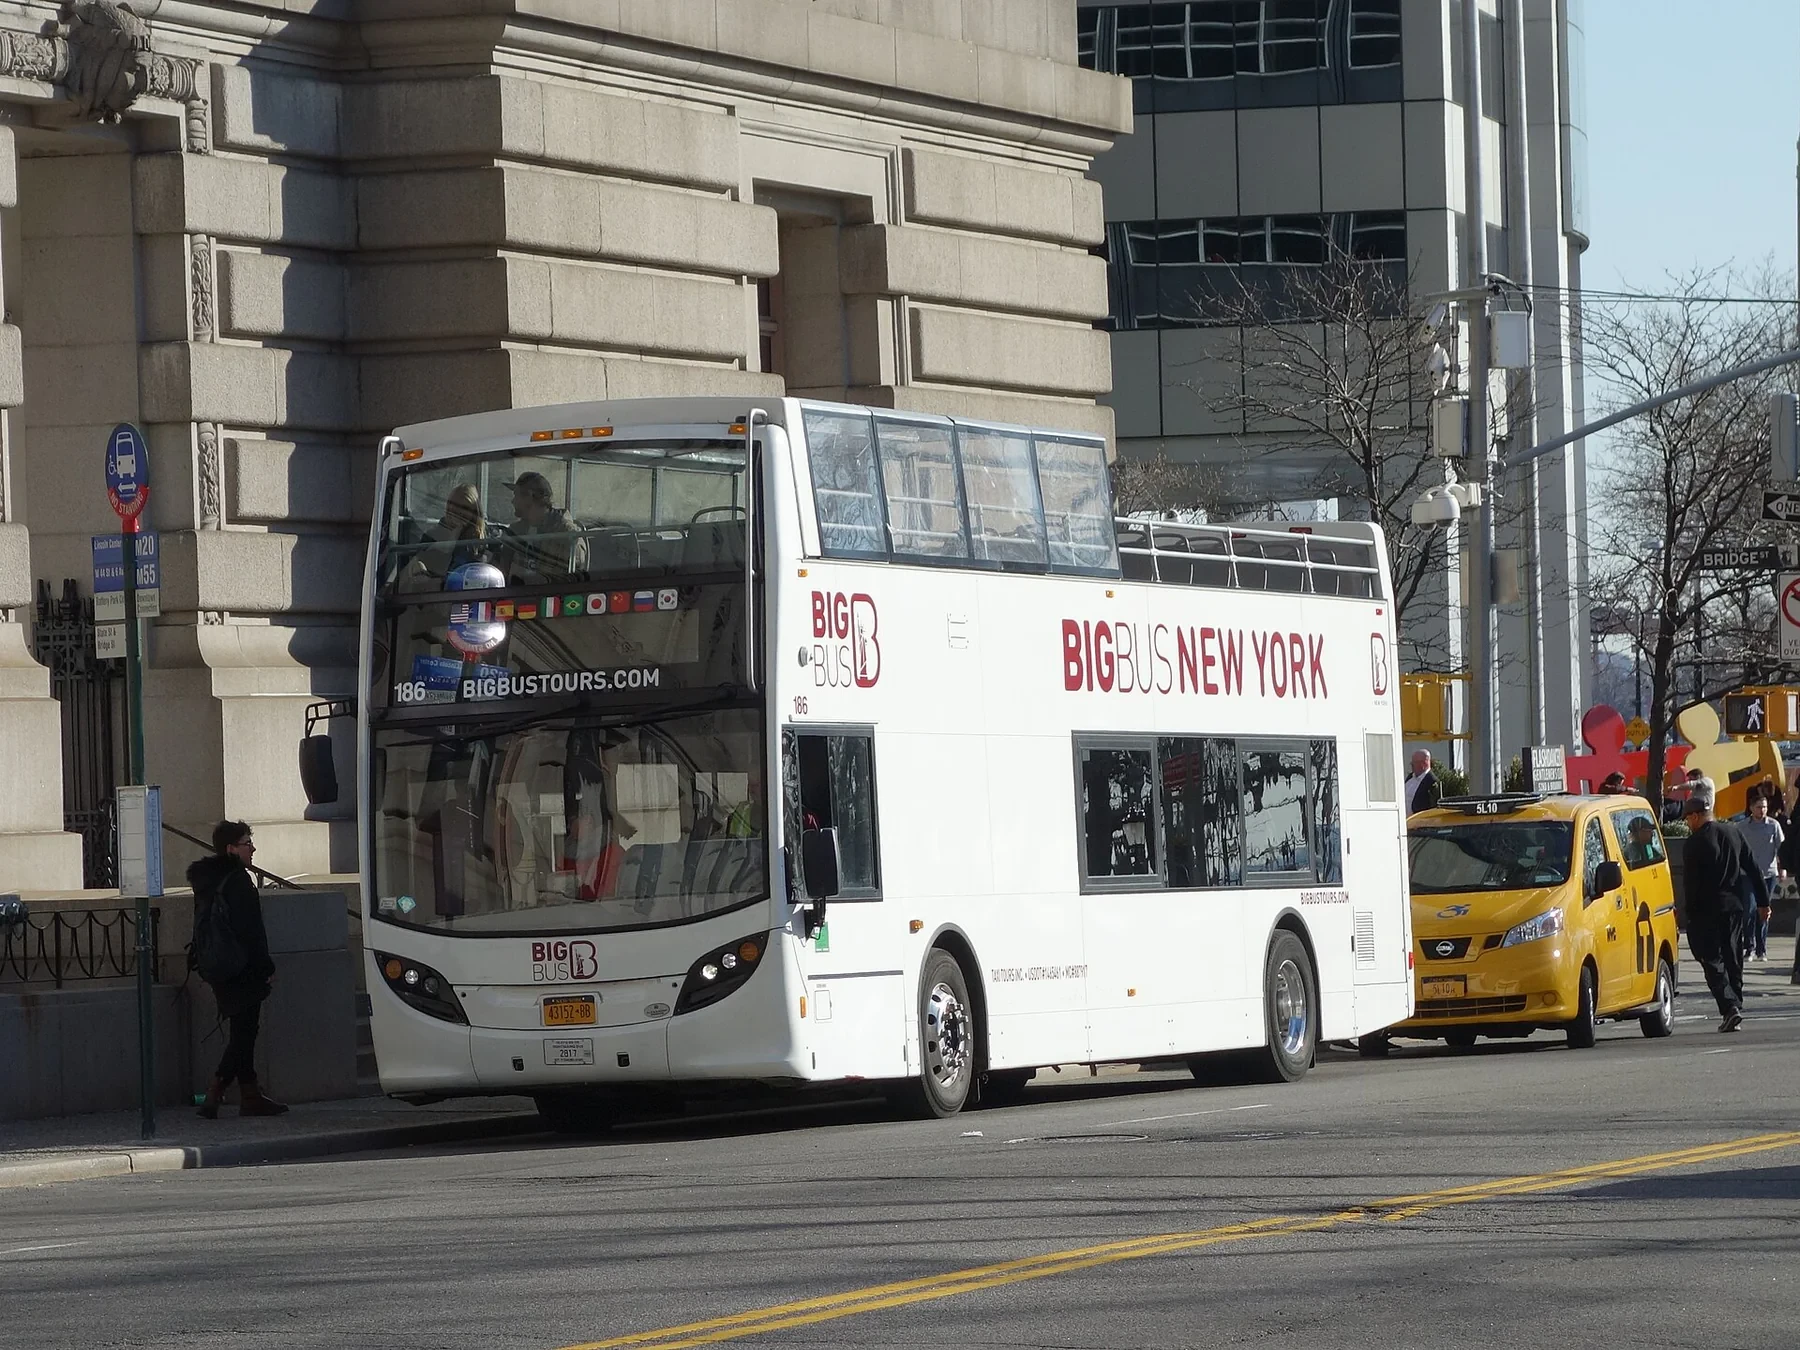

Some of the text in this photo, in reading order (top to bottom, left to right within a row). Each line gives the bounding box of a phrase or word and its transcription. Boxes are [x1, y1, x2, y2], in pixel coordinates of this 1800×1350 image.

[110, 493, 118, 507] NO
[1776, 501, 1799, 513] ONE
[135, 535, 154, 556] M20
[1703, 551, 1769, 567] BRIDGE ST
[136, 563, 156, 585] M55
[811, 591, 848, 639] BIG
[813, 644, 851, 687] BUS
[1177, 625, 1243, 696] NEW
[1252, 630, 1328, 700] YORK
[394, 681, 426, 702] 186
[463, 668, 659, 698] BIGBUSTOURS.COM
[793, 695, 808, 714] 186
[1476, 802, 1498, 814] 5L10
[1300, 891, 1350, 905] BIGBUSTOURS.COM
[532, 941, 568, 962] BIG
[533, 963, 569, 981] BUS
[560, 1049, 577, 1058] 2817
